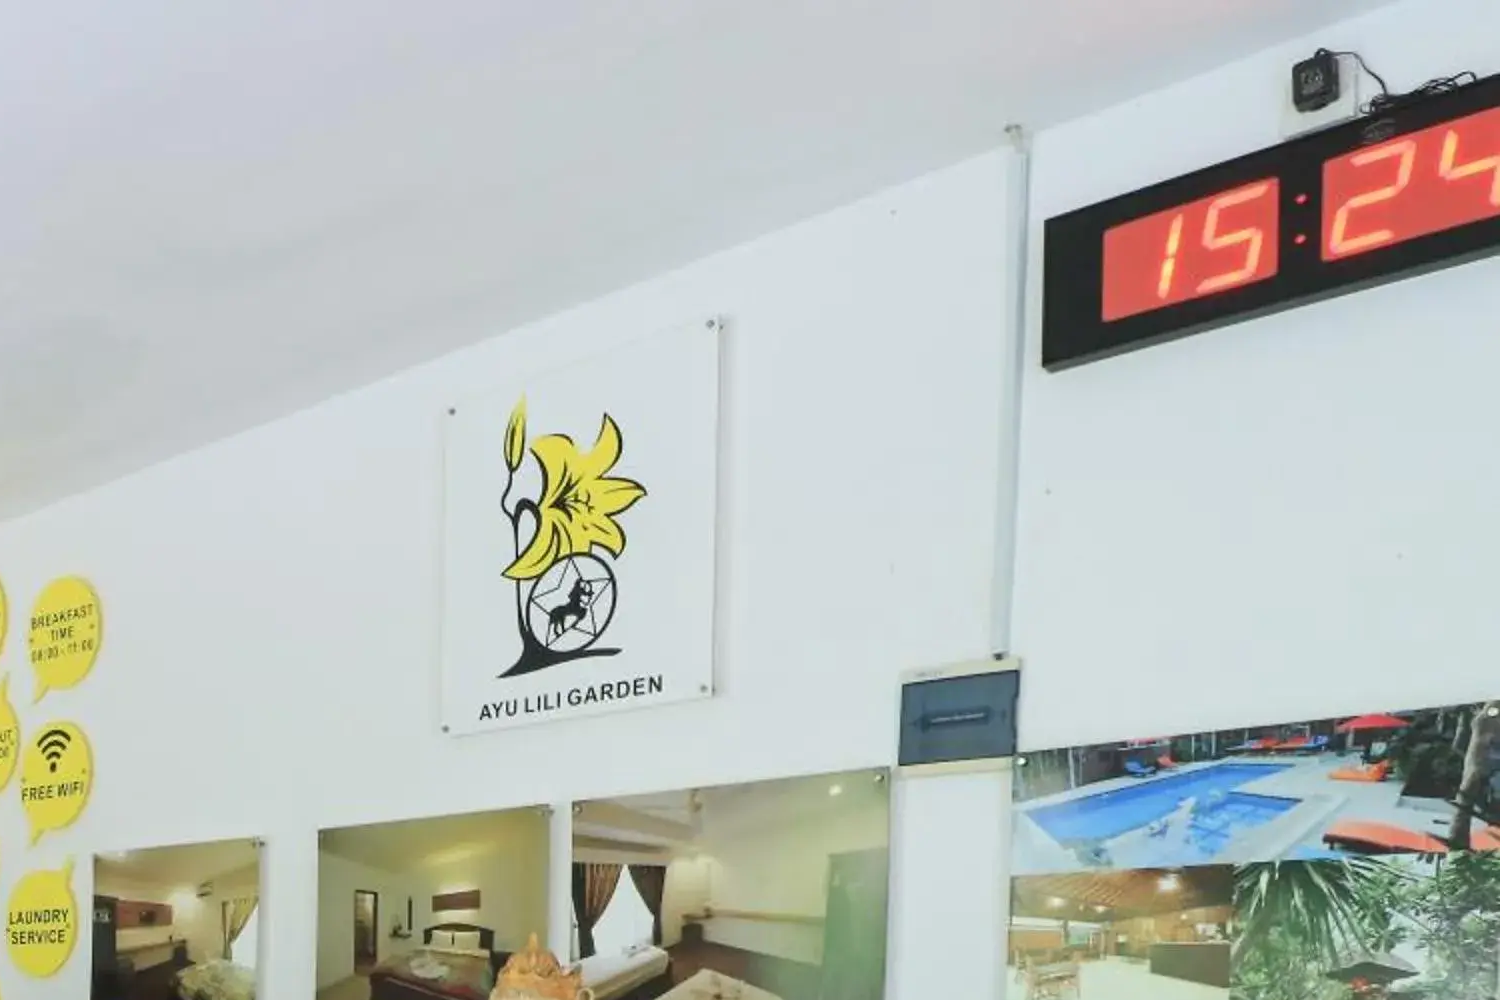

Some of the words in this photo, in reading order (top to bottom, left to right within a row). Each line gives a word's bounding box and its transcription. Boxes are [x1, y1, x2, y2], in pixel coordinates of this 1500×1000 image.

[30, 603, 94, 631] BREAKFAST
[50, 626, 75, 641] TIME
[479, 697, 518, 721] AYU
[524, 691, 562, 714] LILI
[567, 675, 664, 705] GARDEN
[21, 785, 53, 801] FREE
[57, 780, 84, 797] WIFI
[8, 909, 69, 925] LAUNDRY
[11, 929, 66, 945] SERVICE
